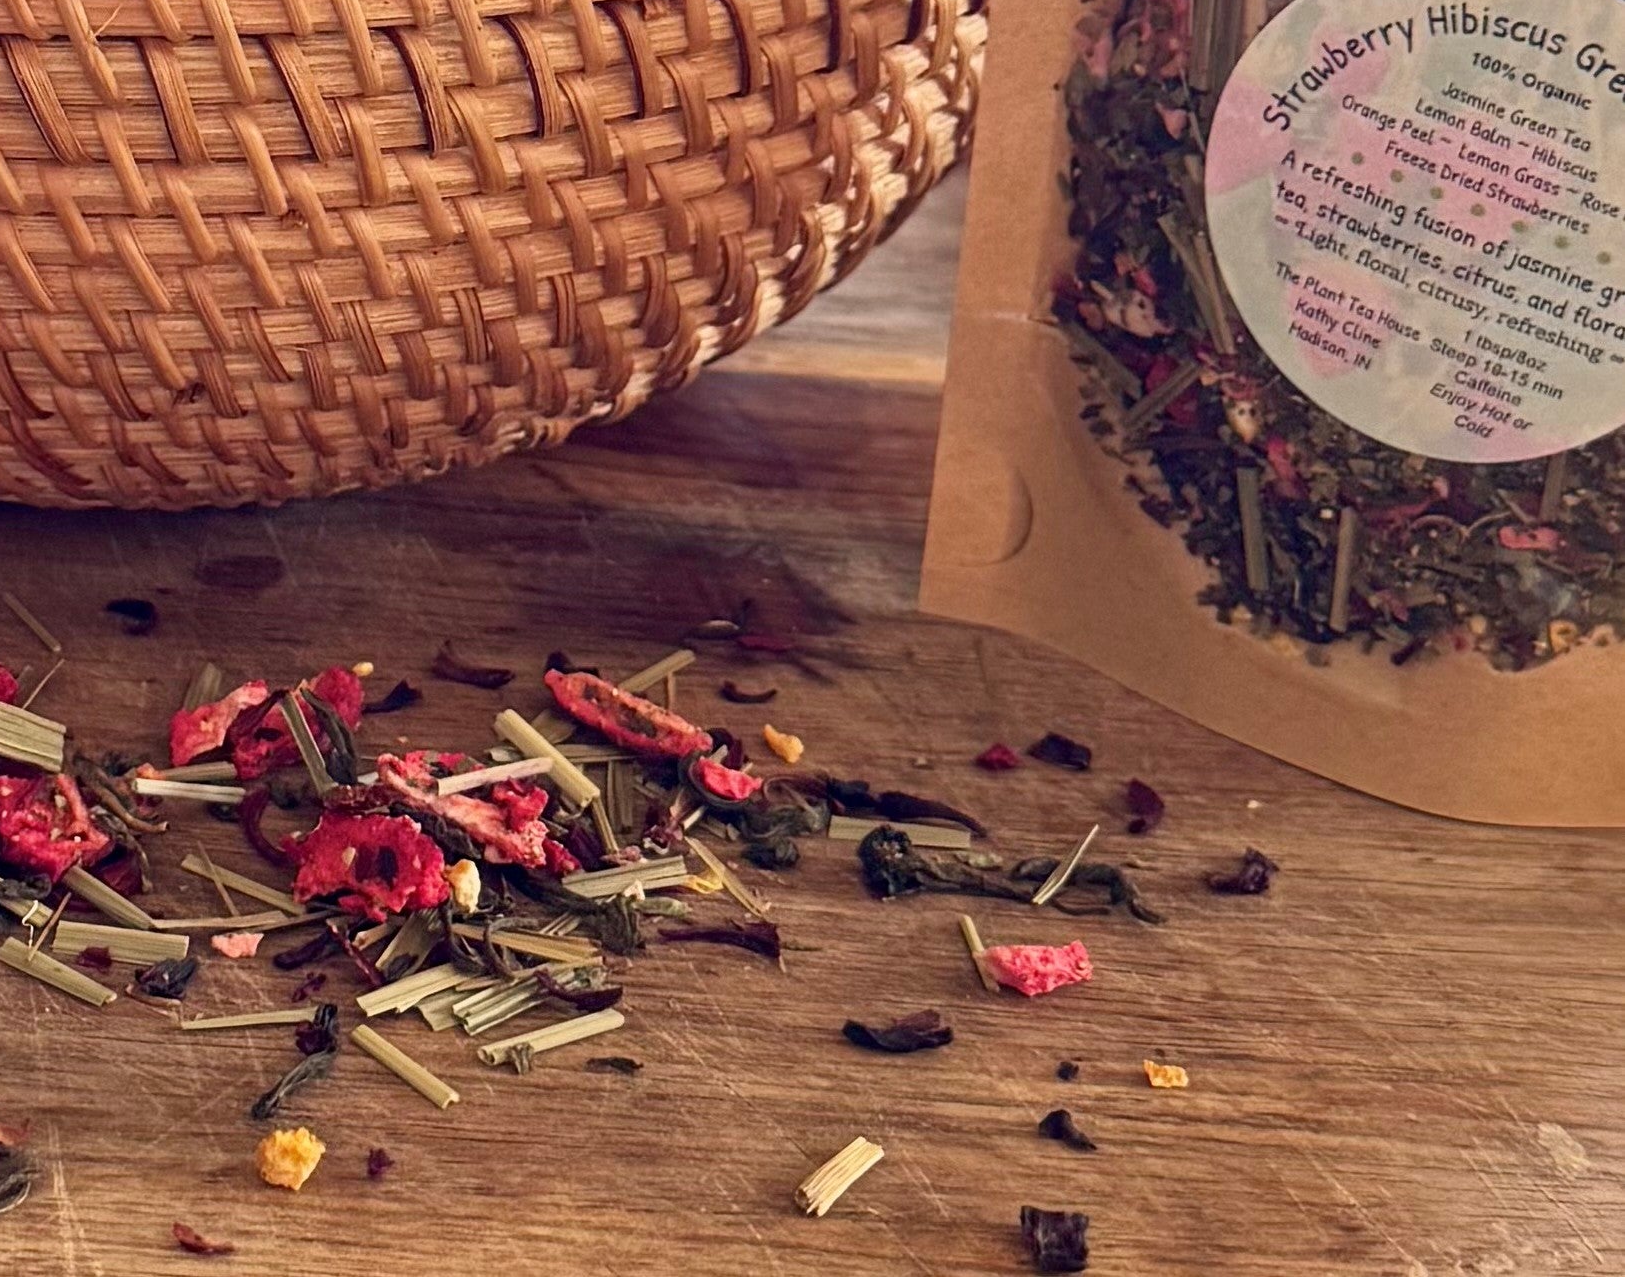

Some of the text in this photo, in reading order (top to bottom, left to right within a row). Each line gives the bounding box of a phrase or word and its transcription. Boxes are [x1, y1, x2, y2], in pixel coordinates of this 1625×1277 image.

[1262, 1, 1625, 132] Strawberry Hibiscus Gre
[1472, 51, 1593, 112] 100% Organic
[1415, 97, 1466, 131] Lemon
[1469, 119, 1512, 150] Balm
[1531, 144, 1599, 184] Hibiscus
[1441, 81, 1593, 153] Jasmine Green Tea
[1341, 93, 1397, 132] Orange
[1399, 118, 1436, 146] Peel
[1457, 142, 1510, 178] Lemon
[1513, 166, 1563, 197] Grass
[1579, 191, 1621, 219] Rose
[1384, 138, 1591, 236] Freeze Dried Strawberries
[1280, 148, 1296, 170] A
[1302, 161, 1408, 228] refreshing
[1413, 205, 1477, 249] fusion
[1481, 239, 1510, 260] of
[1503, 246, 1595, 295] jasmine
[1275, 179, 1625, 342] tea, strawberries, citrus, and flora
[1276, 260, 1422, 342] The Plant Tea House
[1294, 296, 1339, 334] Kathy
[1354, 247, 1411, 289] floral,
[1417, 278, 1491, 322] citrusy,
[1495, 310, 1605, 365] refreshing
[1463, 328, 1473, 344] 1
[1352, 352, 1373, 372] IN
[1429, 336, 1564, 401] Steep 10-15 min
[1453, 369, 1523, 408] Caffeine
[1429, 381, 1535, 432] Enjoy Hot or
[1453, 413, 1496, 440] Cold
